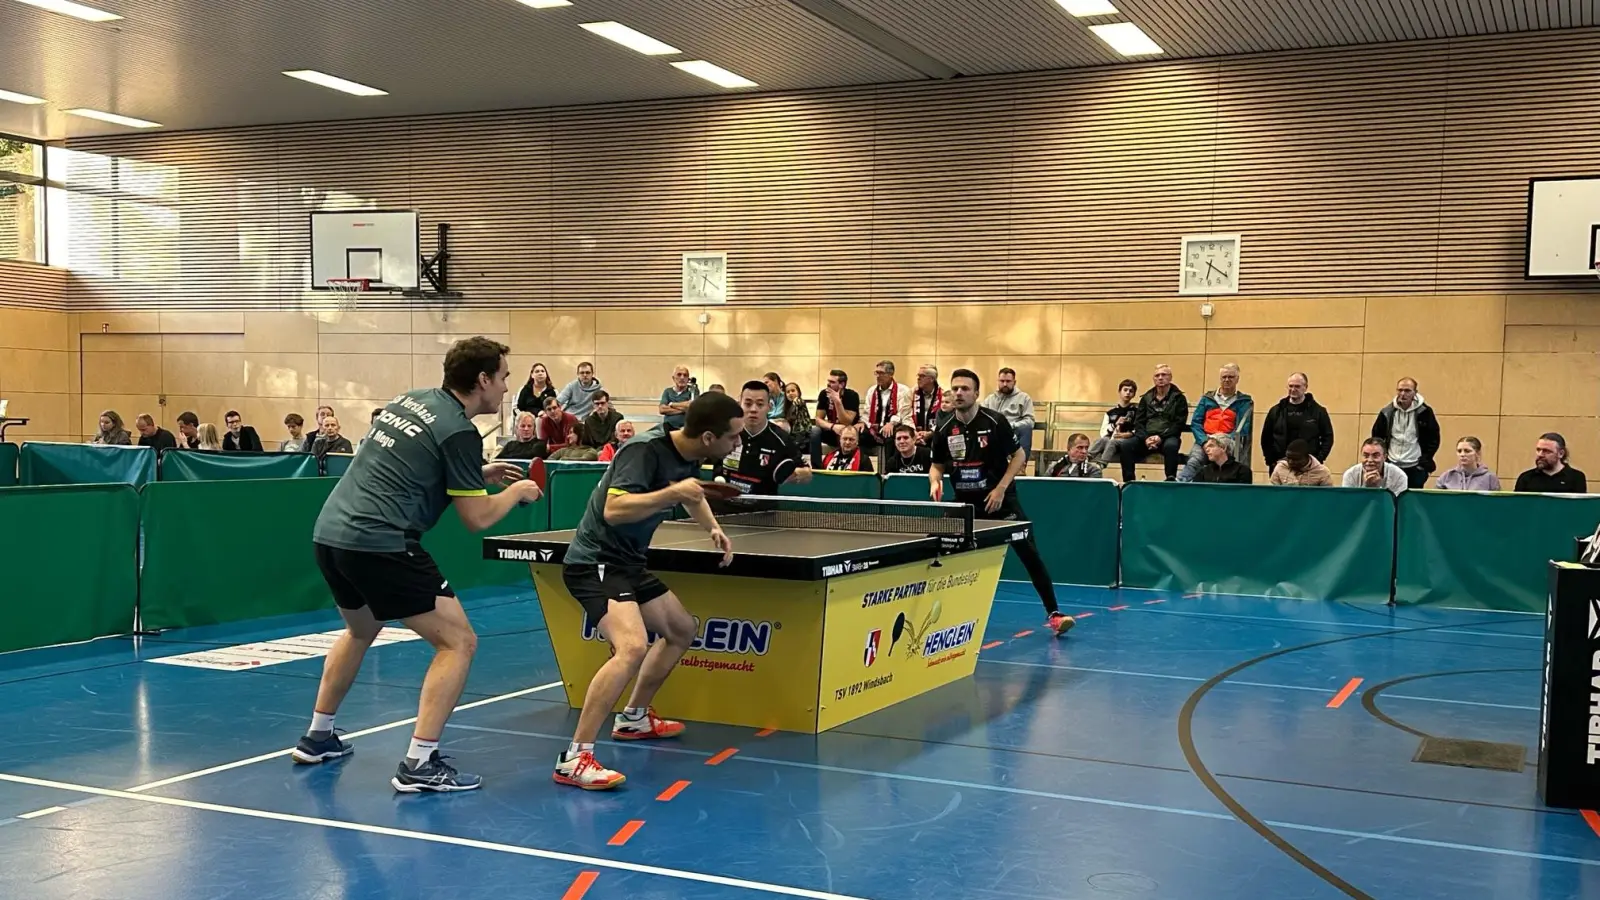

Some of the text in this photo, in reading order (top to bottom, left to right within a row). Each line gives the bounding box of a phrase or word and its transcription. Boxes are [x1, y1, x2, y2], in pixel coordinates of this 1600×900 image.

[497, 548, 537, 561] TIBHAR
[822, 563, 844, 577] TIBHAR
[862, 588, 894, 608] STARKE
[893, 581, 927, 601] PARTNER
[922, 620, 976, 657] HENGLEIN
[680, 656, 755, 673] selbstgemacht
[835, 672, 893, 702] TSV 1892 Windsbach
